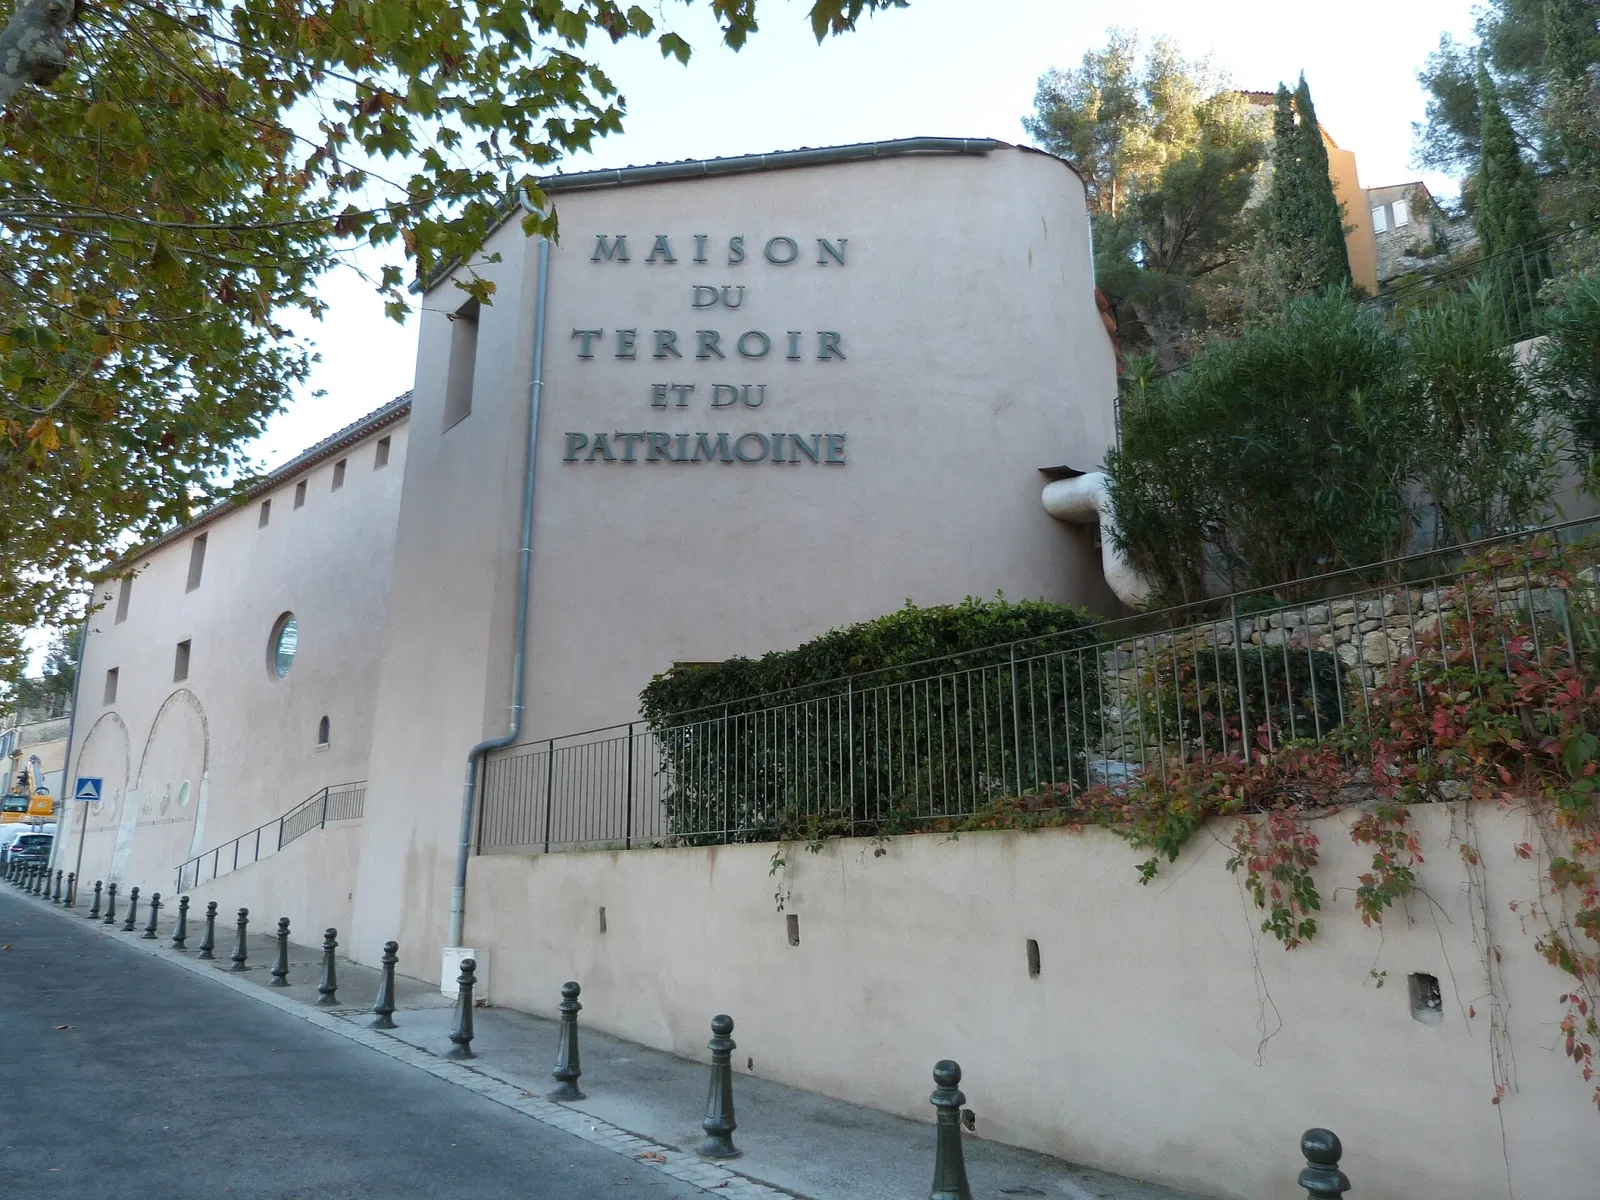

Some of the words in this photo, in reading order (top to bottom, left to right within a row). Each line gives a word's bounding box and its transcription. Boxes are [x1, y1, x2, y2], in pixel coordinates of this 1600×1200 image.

[590, 234, 848, 266] MAISON
[692, 285, 745, 309] DU
[572, 328, 847, 360] TERROIR
[651, 382, 695, 409] ET
[710, 384, 767, 408] DU
[562, 430, 847, 466] PATRIMOINE
